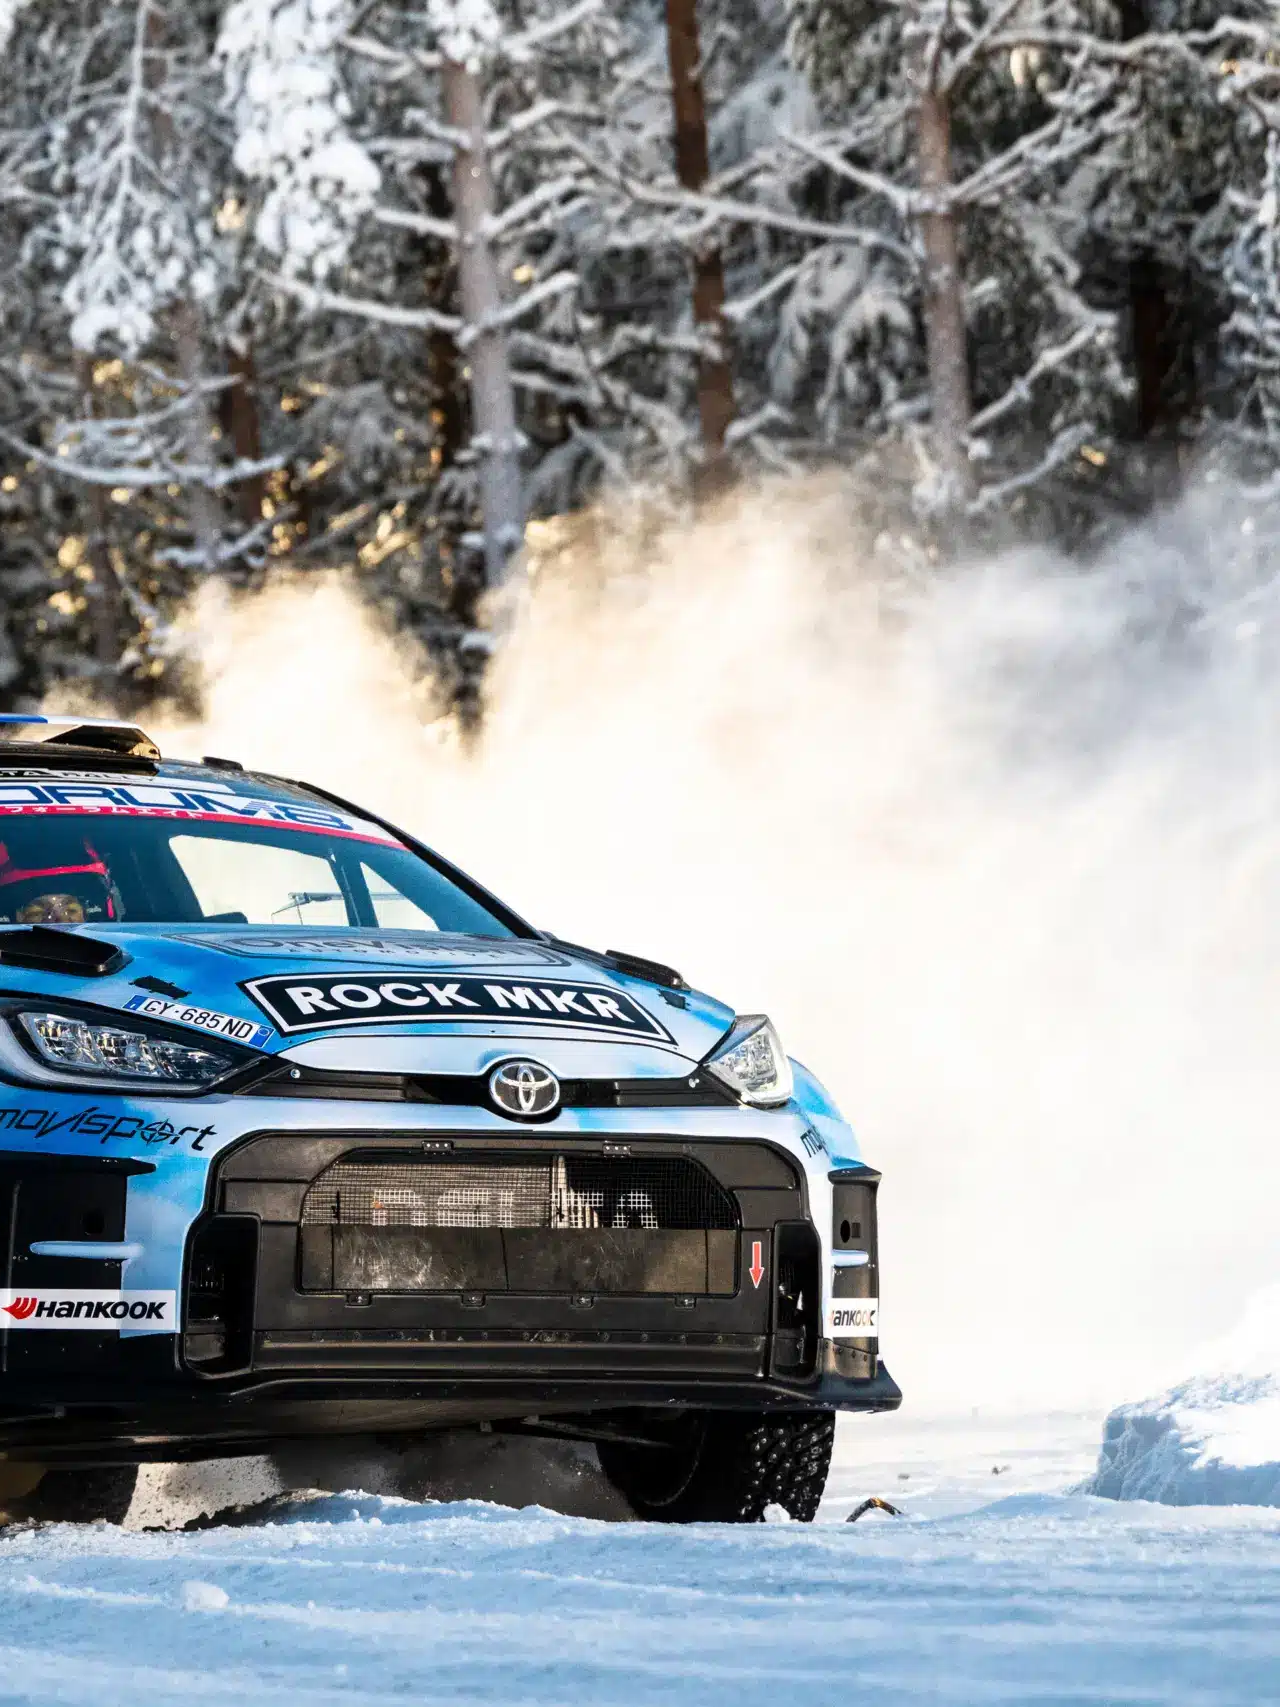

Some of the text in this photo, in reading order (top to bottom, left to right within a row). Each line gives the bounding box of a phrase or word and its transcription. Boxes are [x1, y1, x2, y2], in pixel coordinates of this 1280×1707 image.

[4, 804, 204, 819] フォーラムエイト
[283, 981, 638, 1024] ROCK MKR
